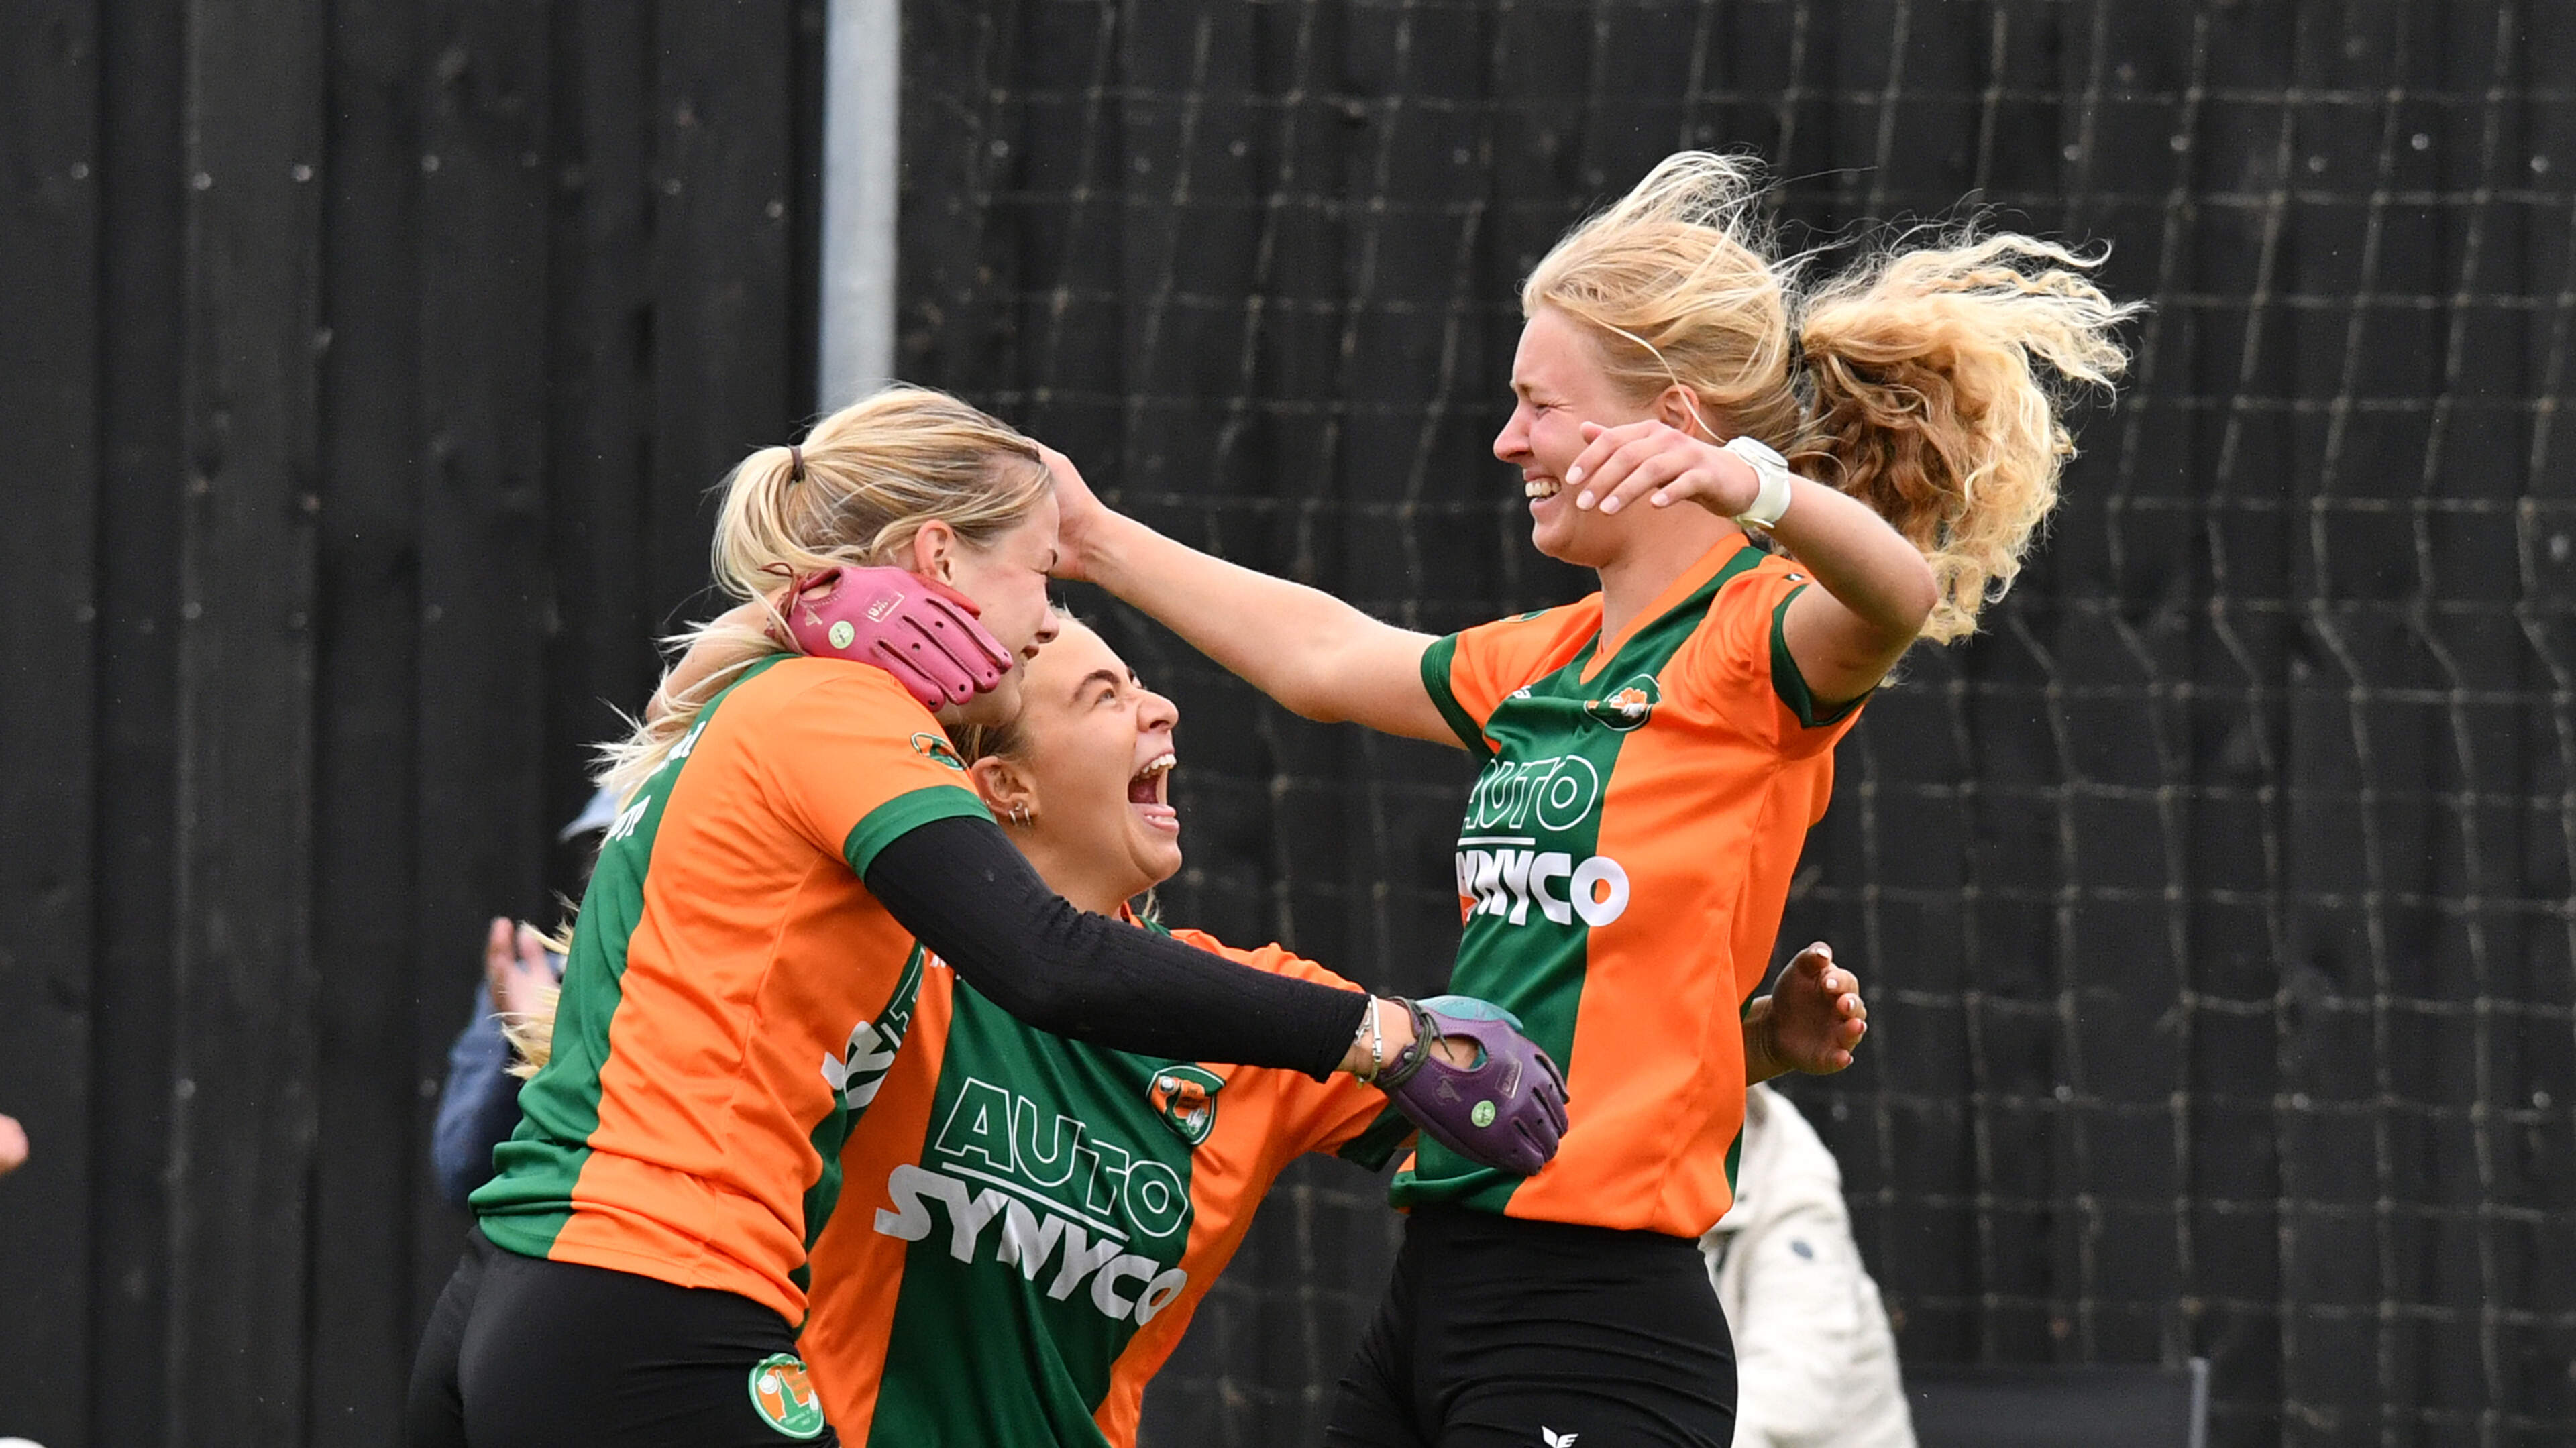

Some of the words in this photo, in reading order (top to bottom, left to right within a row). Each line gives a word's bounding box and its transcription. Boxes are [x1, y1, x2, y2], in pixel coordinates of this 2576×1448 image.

[1455, 849, 1630, 926] YNYCO
[935, 1077, 1189, 1237] AUTO
[873, 1164, 1188, 1326] SYNYCO
